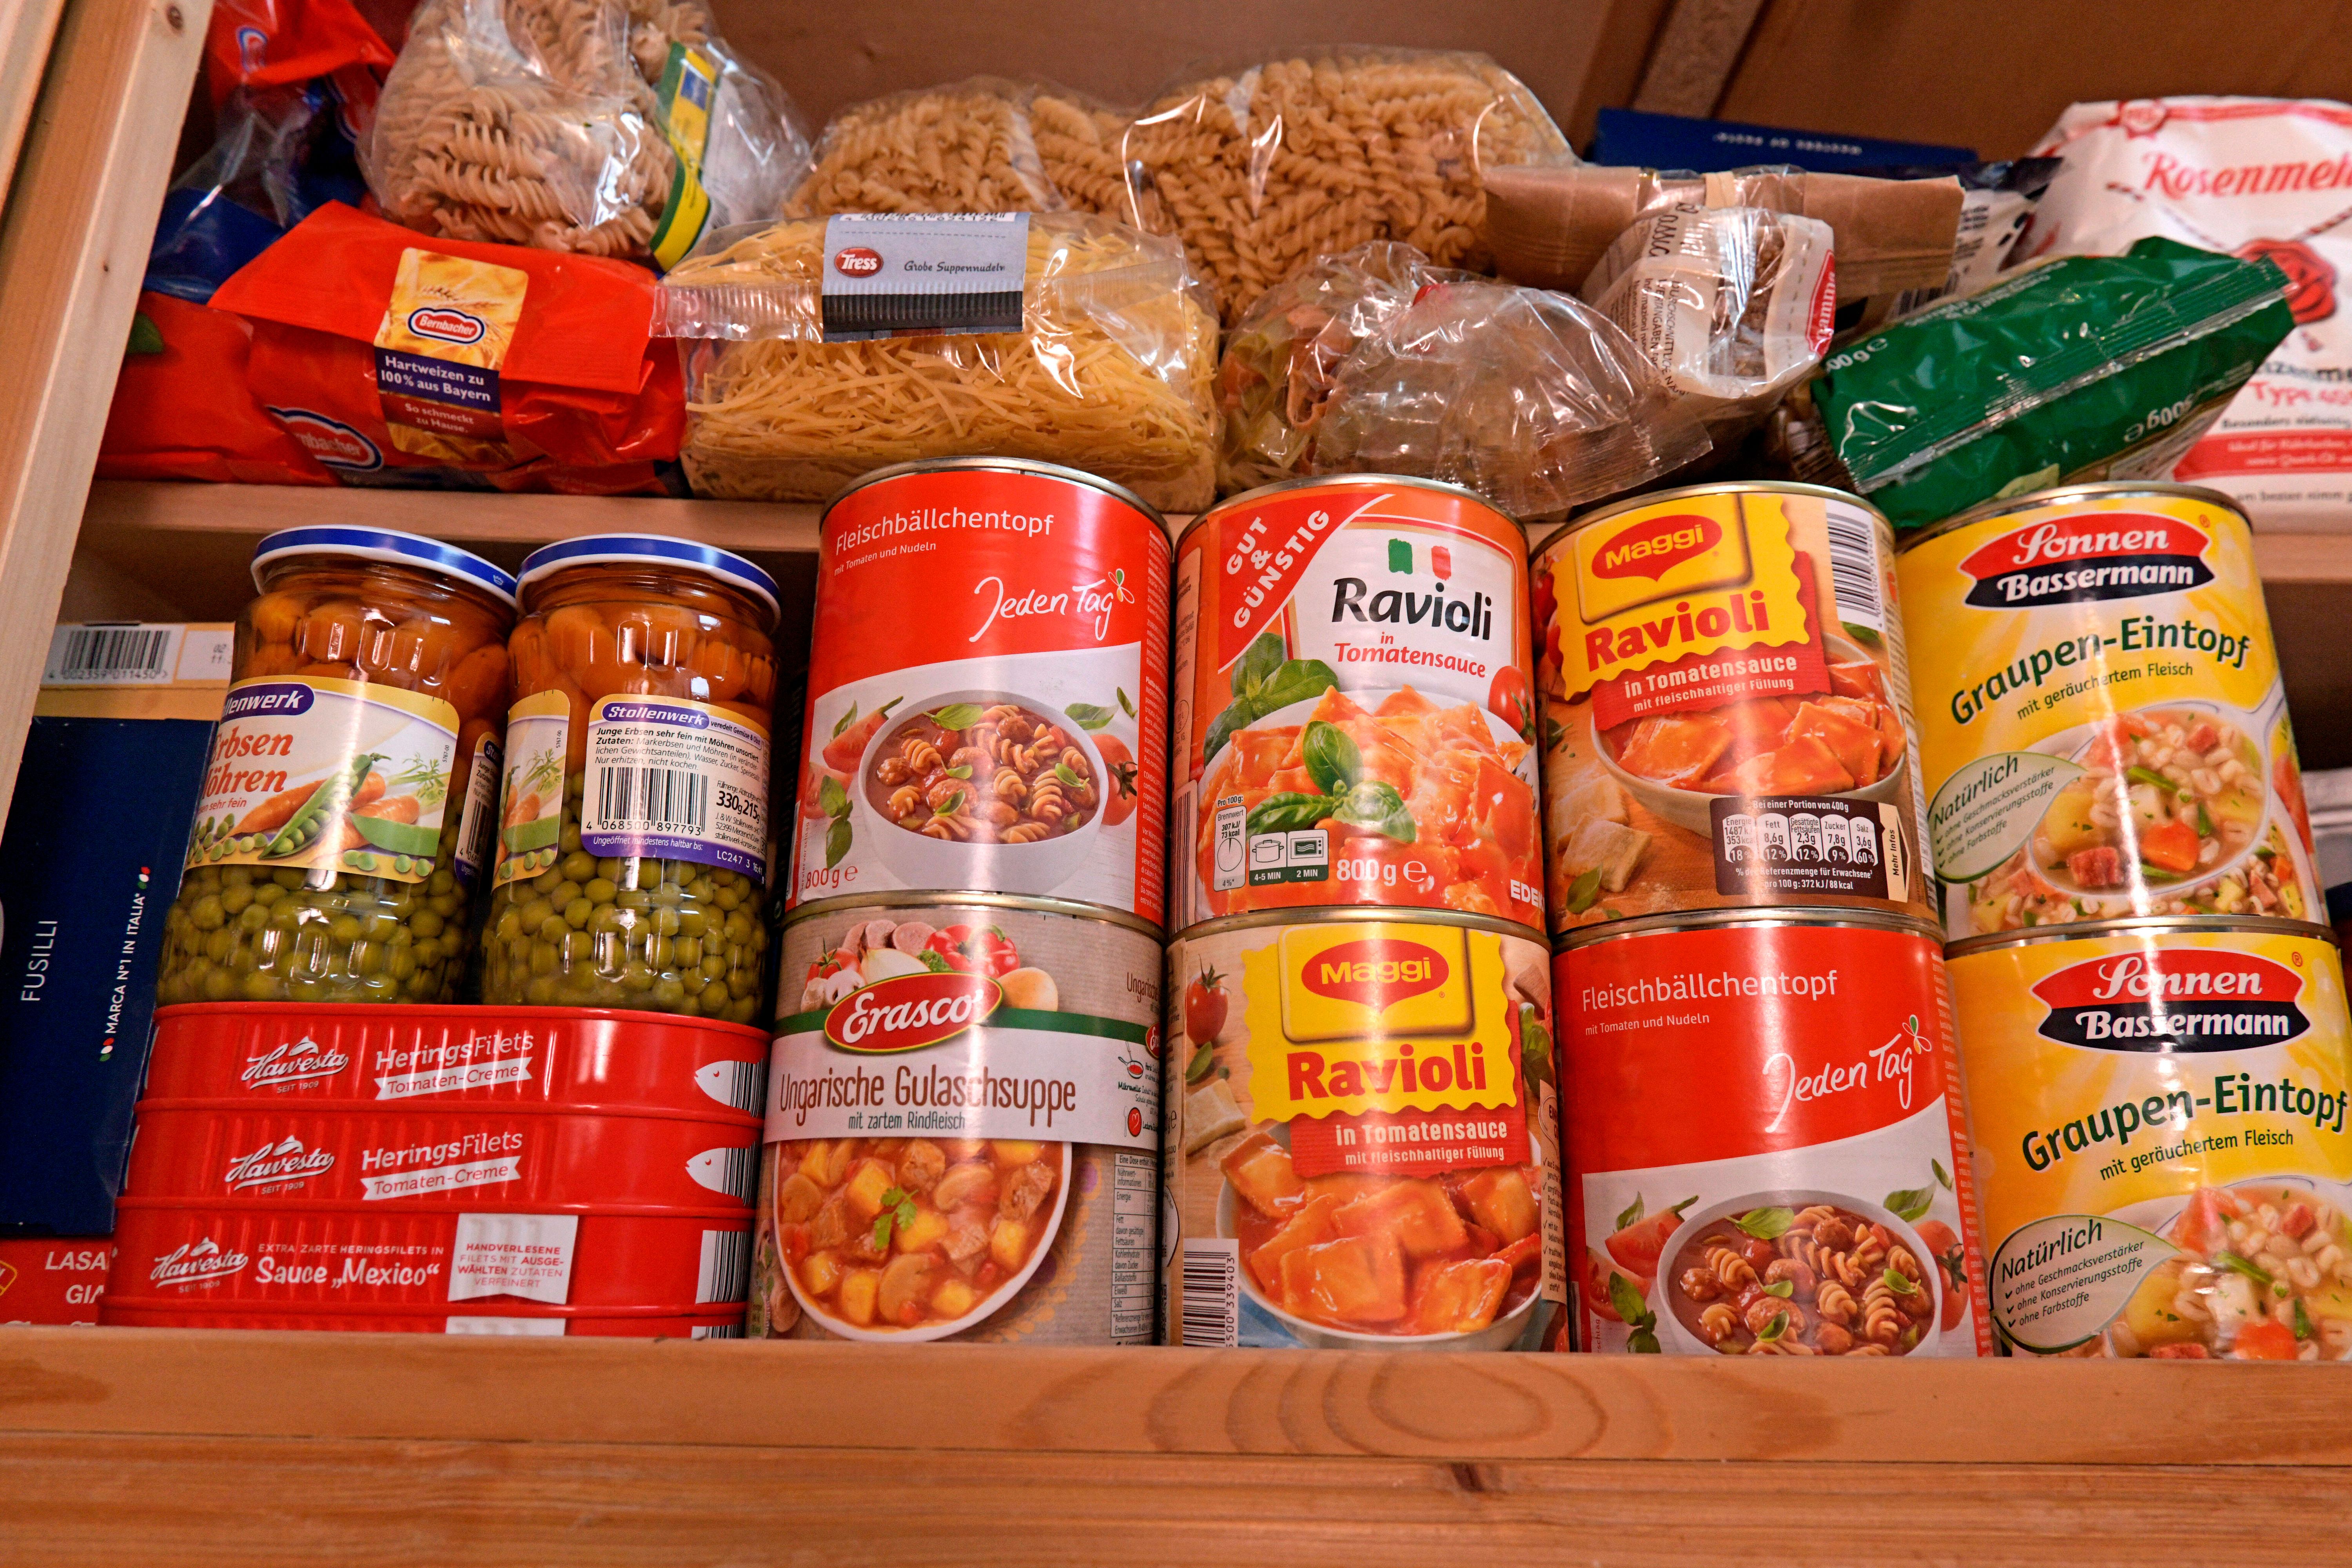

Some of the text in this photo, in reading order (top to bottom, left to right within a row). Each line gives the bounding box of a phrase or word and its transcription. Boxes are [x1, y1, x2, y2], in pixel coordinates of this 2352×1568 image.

[842, 254, 877, 270] Tress
[904, 260, 1005, 274] Grobe Suppennudeln
[420, 314, 474, 336] Bernbacher
[385, 356, 484, 386] Hartweizen zu
[417, 379, 439, 392] aus
[443, 383, 490, 402] Bayern
[417, 418, 468, 434] zu Hause.
[423, 407, 473, 425] schmeckt
[836, 506, 1054, 556] Fleischbällchentopf
[1226, 516, 1268, 575] GUT
[2013, 524, 2169, 566] Sonnen
[845, 541, 936, 570] Tomaten und Nudeln
[1249, 548, 1273, 570] &
[1605, 523, 1705, 570] Maggi
[1233, 510, 1330, 629] GÜNSTIG
[1996, 563, 2194, 602] Bassermann
[968, 575, 1114, 643] Jeden Tag
[1332, 577, 1492, 641] Ravioli
[1585, 590, 1770, 673] Ravioli
[1334, 641, 1486, 678] Tomatensauce
[1950, 615, 2251, 725] Graupen-Eintopf
[1624, 655, 1798, 699] in Tomatensauce
[2017, 662, 2193, 720] mit geräuchertem Fleisch
[1633, 676, 1795, 713] mit fleischhaltiger Füllung
[608, 706, 705, 726] Stollenwerk
[711, 720, 733, 732] veredelt
[596, 727, 760, 763] Junge Erbsen sehr fein Möhren unsortiert.
[621, 747, 691, 760] Gewichtsanteilen),
[637, 737, 684, 749] Markerbsen
[702, 745, 728, 759] Möhren
[648, 757, 668, 766] nicht
[670, 760, 699, 770] kochen.
[716, 790, 742, 815] 330g
[1769, 800, 1787, 809] einer
[1788, 800, 1817, 809] Portion
[1817, 802, 1831, 810] von
[1933, 755, 2018, 831] Natürlich
[1963, 766, 2055, 824] Geschmacksverstärker
[1965, 780, 2054, 835] Konservierungsstoffe
[602, 820, 701, 836] 068500 897793
[1218, 809, 1244, 821] Brennwert
[1765, 820, 1869, 833] Fett Zucker Salz
[1790, 817, 1819, 827] Gesättigte
[593, 836, 692, 849] Ungeöffnet haltbar
[1790, 826, 1820, 834] Fettsäuren
[1967, 818, 2008, 851] Farbstoffe
[717, 850, 743, 865] LC247
[805, 867, 829, 890] 800
[1267, 871, 1281, 880] MIN
[1303, 869, 1318, 877] MIN
[1838, 880, 1853, 889] kcal
[21, 921, 58, 1001] FUSILLI
[1320, 956, 1432, 985] Maggi
[104, 985, 126, 1034] MARCA
[122, 940, 136, 954] IN
[1582, 970, 1838, 1012] Fleischbällchentopf
[2092, 956, 2263, 1000] Sonnen
[842, 989, 976, 1044] Erasco
[1585, 1012, 1710, 1036] mit Tomaten und Nudeln
[2075, 1011, 2289, 1040] Bassermann
[241, 1043, 349, 1081] Hawesta
[375, 1034, 534, 1071] HeringsFilets
[387, 1065, 519, 1094] Tomaten-Creme
[1286, 1042, 1487, 1101] Ravioli
[1762, 1033, 1914, 1133] Jeden Tag
[780, 1066, 885, 1127] Ungarische
[895, 1065, 1076, 1128] Gulaschsuppe
[848, 1112, 902, 1130] mit zartem
[1336, 1121, 1508, 1146] in Tomatensauce
[2021, 1072, 2348, 1172] Graupen-Eintopf
[225, 1143, 335, 1183] Hawesta
[361, 1131, 523, 1171] HeringsFilets
[1345, 1146, 1504, 1165] mit Füllung
[2100, 1129, 2294, 1180] mit geräuchertem Fleisch
[374, 1165, 508, 1195] Tomaten-Creme
[1116, 1192, 1131, 1201] Energie
[258, 1243, 427, 1256] EXTRA ZARTE HERINGSFILETS
[466, 1243, 561, 1255] HANDVERLESENE
[1115, 1237, 1135, 1245] Fettsäuren
[2002, 1218, 2102, 1283] Natürlich
[150, 1243, 249, 1282] Hawesta
[256, 1256, 328, 1285] Sauce
[457, 1265, 563, 1277] WÄHLTEN ZUTATEN
[459, 1255, 564, 1266] FILETS AUSGE-
[2015, 1240, 2145, 1295] ohne Geschmacksverstärker
[474, 1278, 541, 1288] VERFEINERT
[1226, 1257, 1235, 1308] 339403
[2017, 1257, 2143, 1311] ohne Konservierungsstoffe
[1114, 1299, 1122, 1308] Salz
[2019, 1291, 2090, 1326] ohne Farbstoffe
